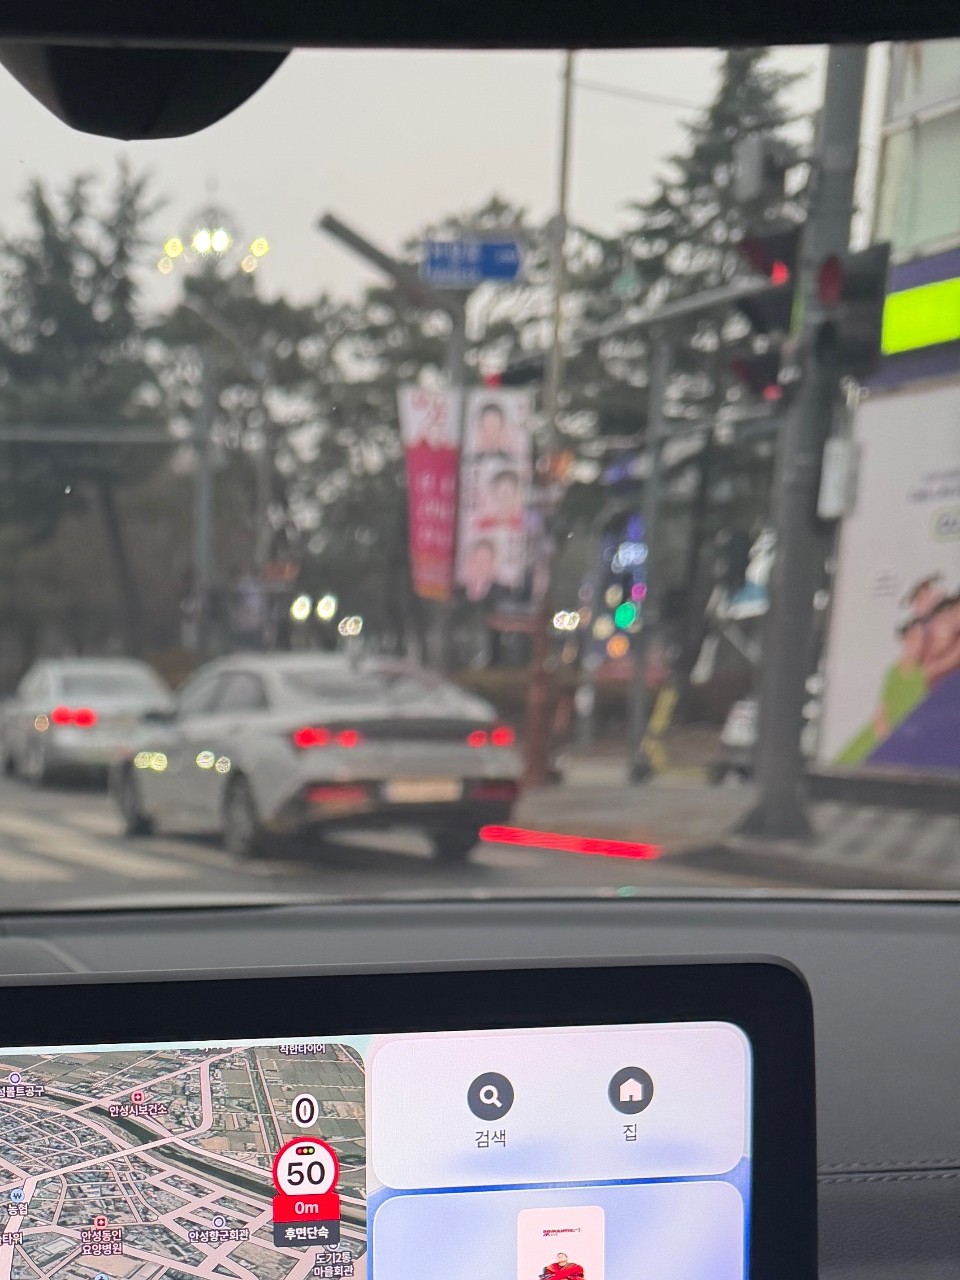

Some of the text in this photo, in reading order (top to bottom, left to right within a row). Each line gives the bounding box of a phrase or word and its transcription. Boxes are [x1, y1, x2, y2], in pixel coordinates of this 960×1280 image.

[109, 1104, 168, 1117] 안성시보건소
[296, 1098, 314, 1124] 0
[475, 1129, 507, 1148] 검색
[623, 1123, 638, 1142] 집
[287, 1161, 325, 1186] 50
[7, 1203, 28, 1215] 농협
[294, 1201, 319, 1214] 0m
[81, 1230, 122, 1242] 안성동인
[189, 1229, 250, 1242] 안성향군회관
[284, 1226, 330, 1240] 후면단속
[81, 1243, 122, 1255] 요양병원
[314, 1265, 354, 1277] 마을회관
